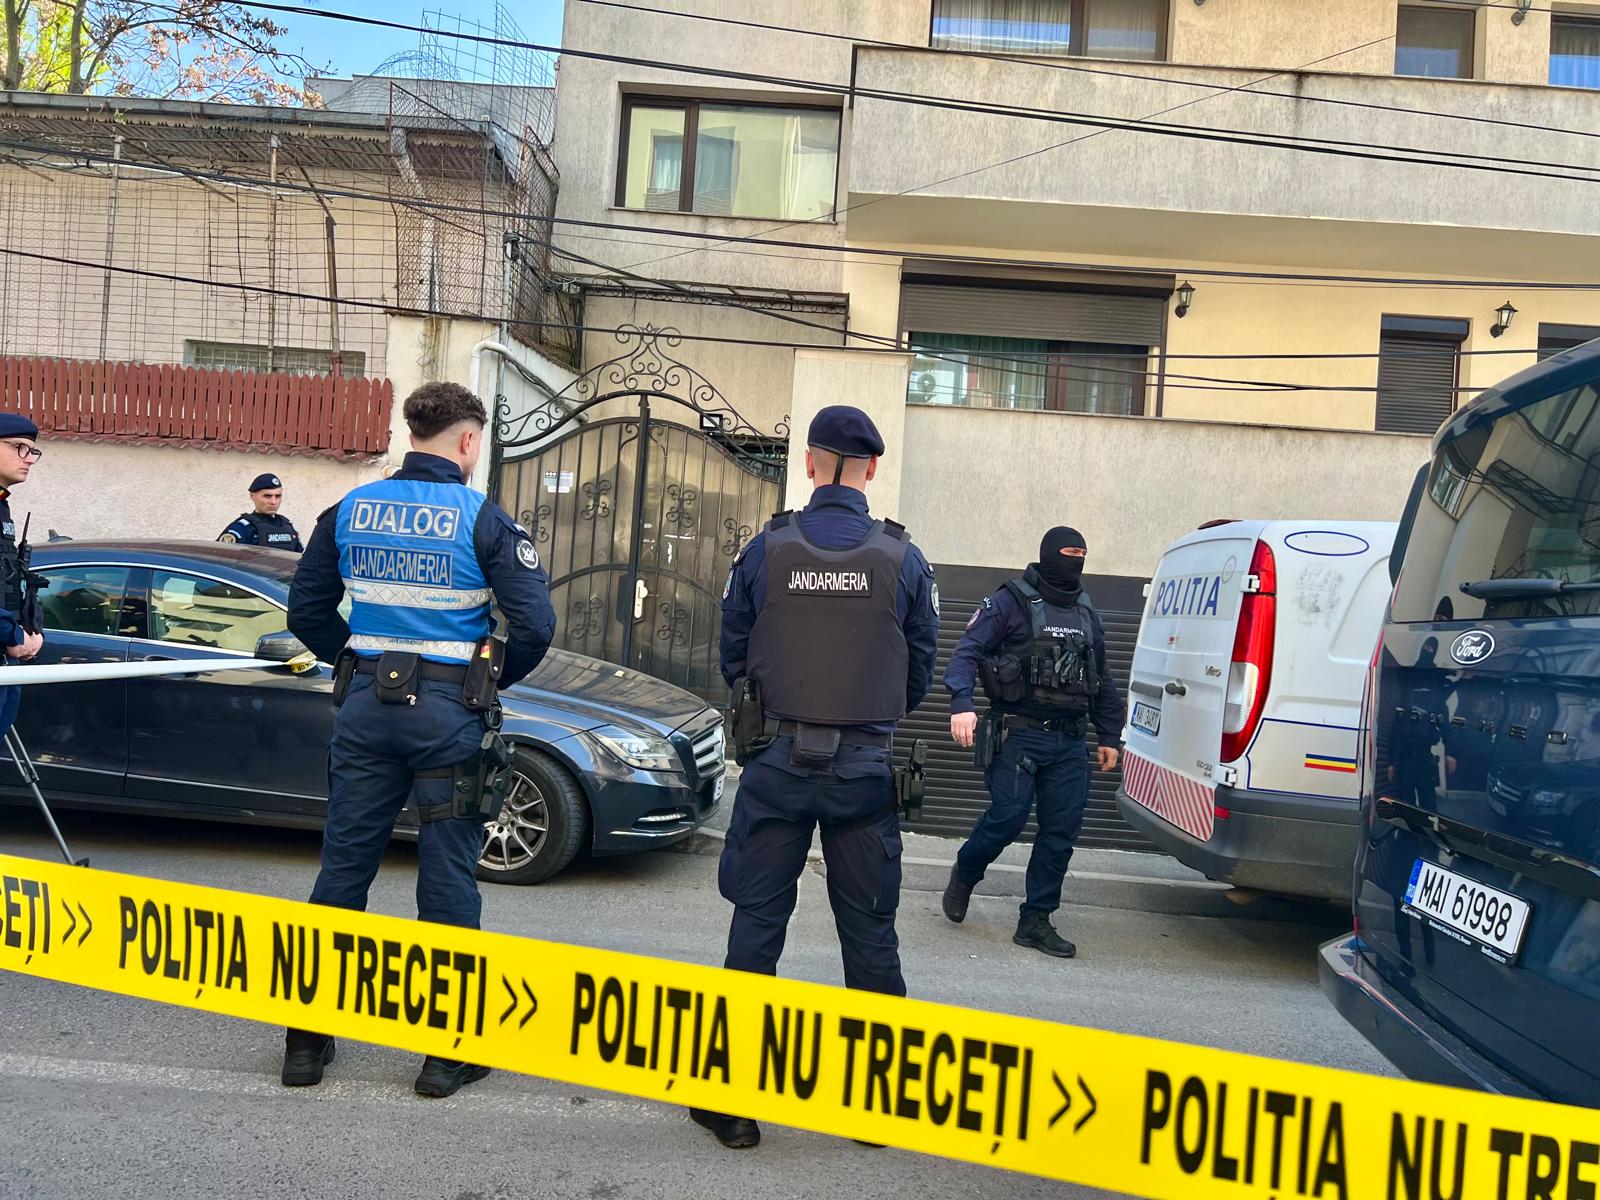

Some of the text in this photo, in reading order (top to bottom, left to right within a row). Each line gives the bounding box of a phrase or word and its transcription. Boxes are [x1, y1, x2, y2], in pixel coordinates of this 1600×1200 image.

[355, 503, 455, 538] DIALOG
[353, 548, 450, 584] JANDARMERIA
[788, 571, 868, 591] JANDARMERIA
[1456, 635, 1486, 658] Ford
[1418, 868, 1451, 914] MAI
[1451, 883, 1512, 942] 61998
[0, 875, 50, 965] EȚI
[119, 895, 248, 998] POLIȚIA
[270, 921, 320, 1005] NU
[332, 931, 487, 1048] TRECEȚI
[570, 971, 730, 1091] POLIȚIA
[758, 1003, 823, 1100] NU
[838, 1016, 1033, 1154] TRECEȚI
[1387, 1112, 1468, 1200] NU
[1488, 1127, 1600, 1200] TRE
